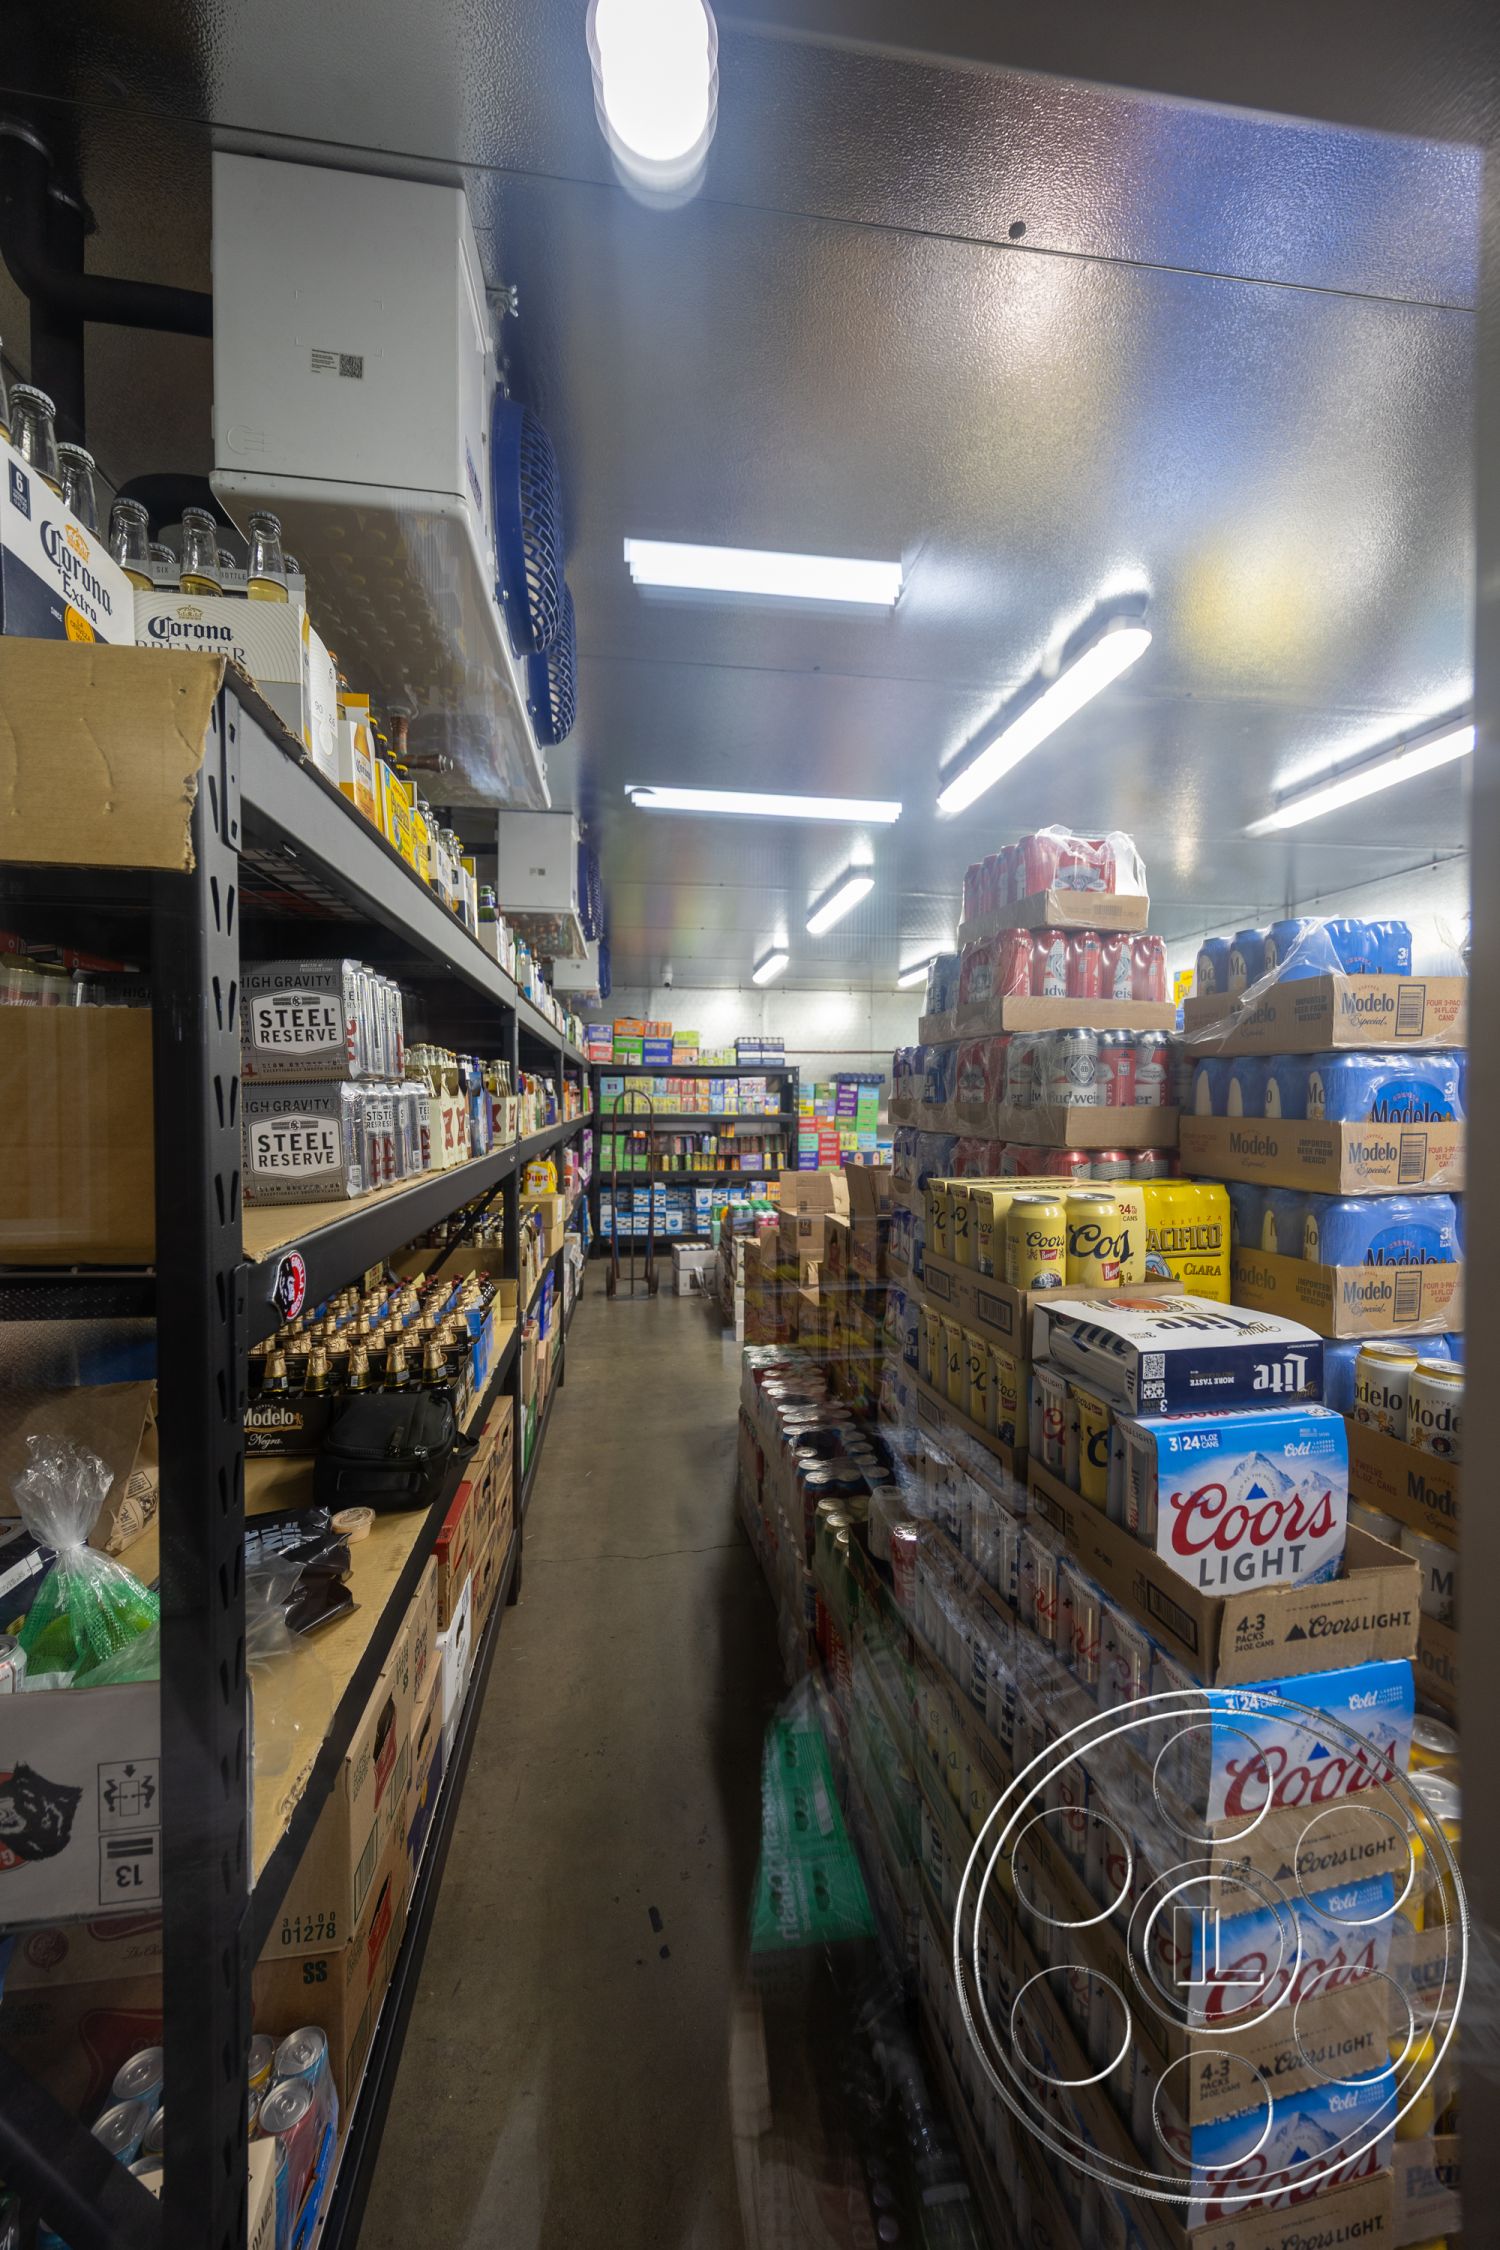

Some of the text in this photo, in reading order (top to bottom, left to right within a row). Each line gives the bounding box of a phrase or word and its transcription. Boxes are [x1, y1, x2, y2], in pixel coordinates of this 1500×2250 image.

[15, 470, 24, 493] 6
[40, 520, 112, 616] Corona
[156, 566, 169, 574] SIX
[58, 568, 98, 624] Extra
[147, 615, 234, 643] Corona
[1397, 947, 1407, 960] 3
[274, 975, 331, 988] GRAVITY
[1342, 992, 1395, 1014] Modelo
[259, 1007, 336, 1029] STEEL
[1351, 1014, 1387, 1029] Especial
[1438, 1014, 1455, 1022] CANS
[260, 1028, 337, 1043] RESERVE
[1444, 1082, 1454, 1094] 3
[244, 1099, 330, 1113] IGH GRAVITY
[258, 1132, 334, 1152] STEEL
[1230, 1132, 1278, 1157] Modelo
[259, 1151, 335, 1167] RESERVE
[1348, 1142, 1398, 1164] Modelo
[1355, 1163, 1390, 1177] Especial
[1119, 1204, 1131, 1216] 24
[1160, 1215, 1223, 1227] CERVEZA
[1026, 1231, 1065, 1248] Coors
[1146, 1223, 1223, 1252] ACIFICO
[1439, 1227, 1449, 1241] 3
[1183, 1262, 1222, 1276] CLARA
[1343, 1281, 1392, 1304] Modelo
[1423, 1282, 1440, 1290] FOUR
[1351, 1302, 1385, 1317] Especial
[1190, 1377, 1235, 1387] MORE TASTE
[1253, 1353, 1309, 1393] Lite
[1160, 1399, 1168, 1412] 3
[1354, 1382, 1402, 1410] odelo
[243, 1408, 294, 1426] Modelo
[248, 1433, 282, 1449] Negra
[1168, 1437, 1178, 1452] 3
[1183, 1435, 1201, 1451] 24
[1201, 1440, 1219, 1449] CANS
[1283, 1441, 1311, 1457] Cold
[1170, 1483, 1337, 1556] Coors
[1199, 1544, 1306, 1587] LIGHT
[1236, 1614, 1266, 1633] 4-3
[1308, 1611, 1411, 1639] Coors LIGHT
[1235, 1632, 1264, 1645] PACKS
[1255, 1640, 1274, 1649] CANS
[1349, 1690, 1378, 1711] Cold
[1224, 1740, 1400, 1818] Coors
[1298, 1852, 1348, 1875] Coors
[1350, 1836, 1395, 1860] LIGHT
[116, 1865, 144, 1888] 13
[1329, 1891, 1358, 1913] Cold
[282, 1922, 336, 1945] 01278
[303, 1960, 328, 1985] SS
[1205, 1939, 1380, 2023] Coors
[1275, 2032, 1373, 2075] Coors LIGHT
[1201, 2060, 1230, 2080] 4-3
[1201, 2077, 1230, 2091] PACKS
[1329, 2091, 1358, 2113] Cold
[1205, 2143, 1382, 2225] Coors
[1336, 2215, 1384, 2242] LIGHT
